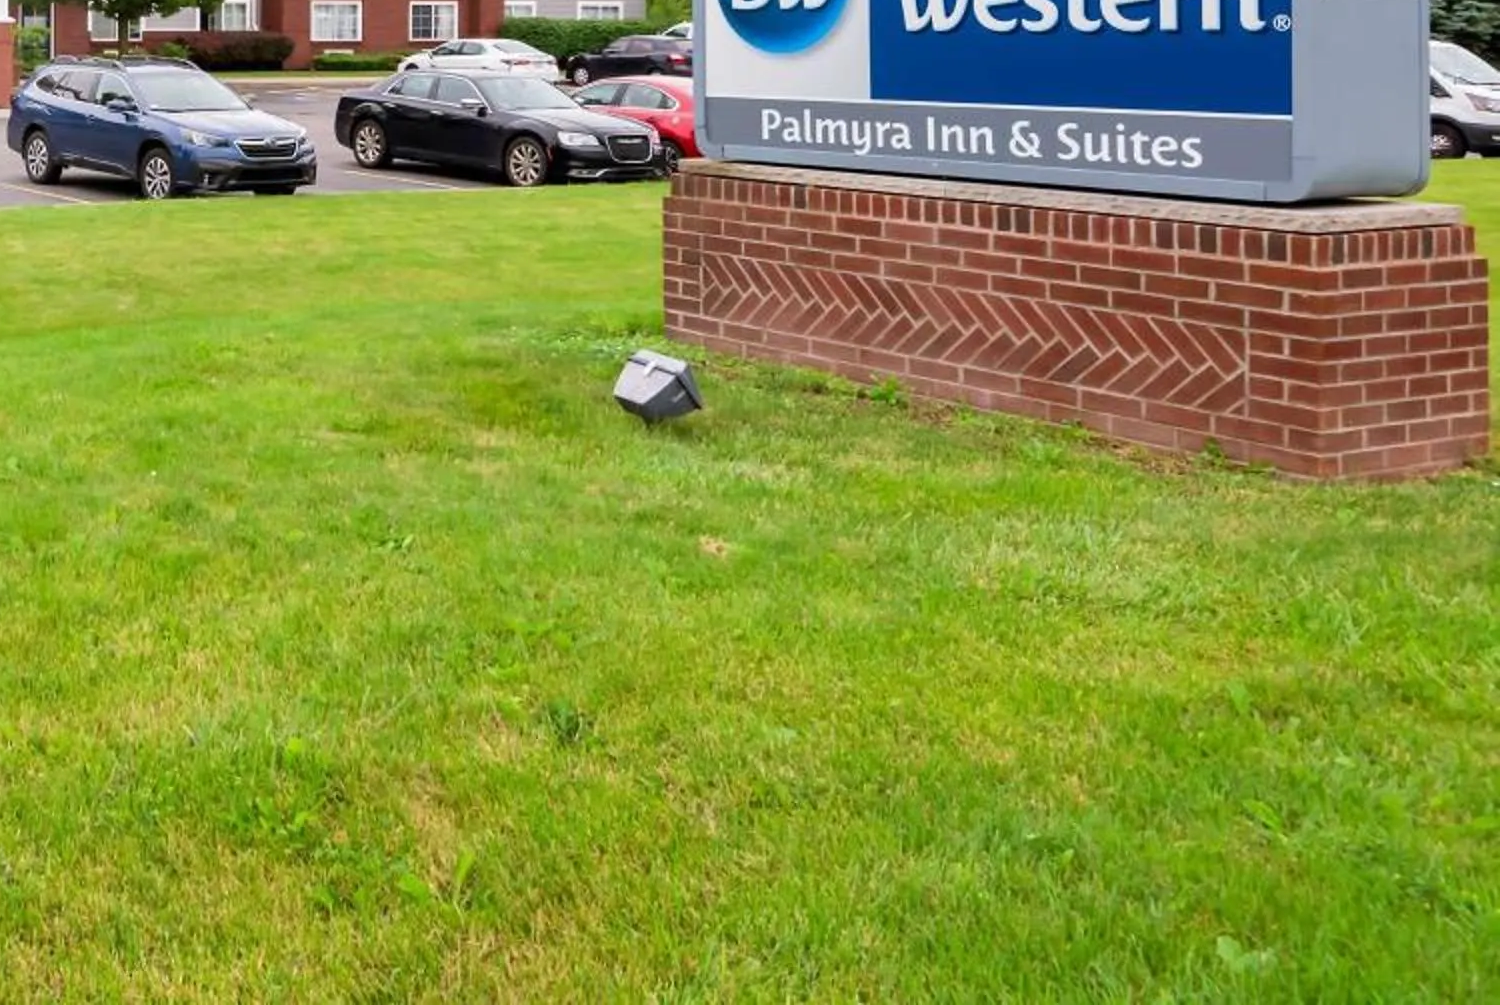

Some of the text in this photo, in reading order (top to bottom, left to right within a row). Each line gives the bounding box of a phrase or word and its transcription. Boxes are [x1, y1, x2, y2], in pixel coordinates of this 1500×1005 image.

[760, 108, 1204, 168] Palmyra Inn & Suites
